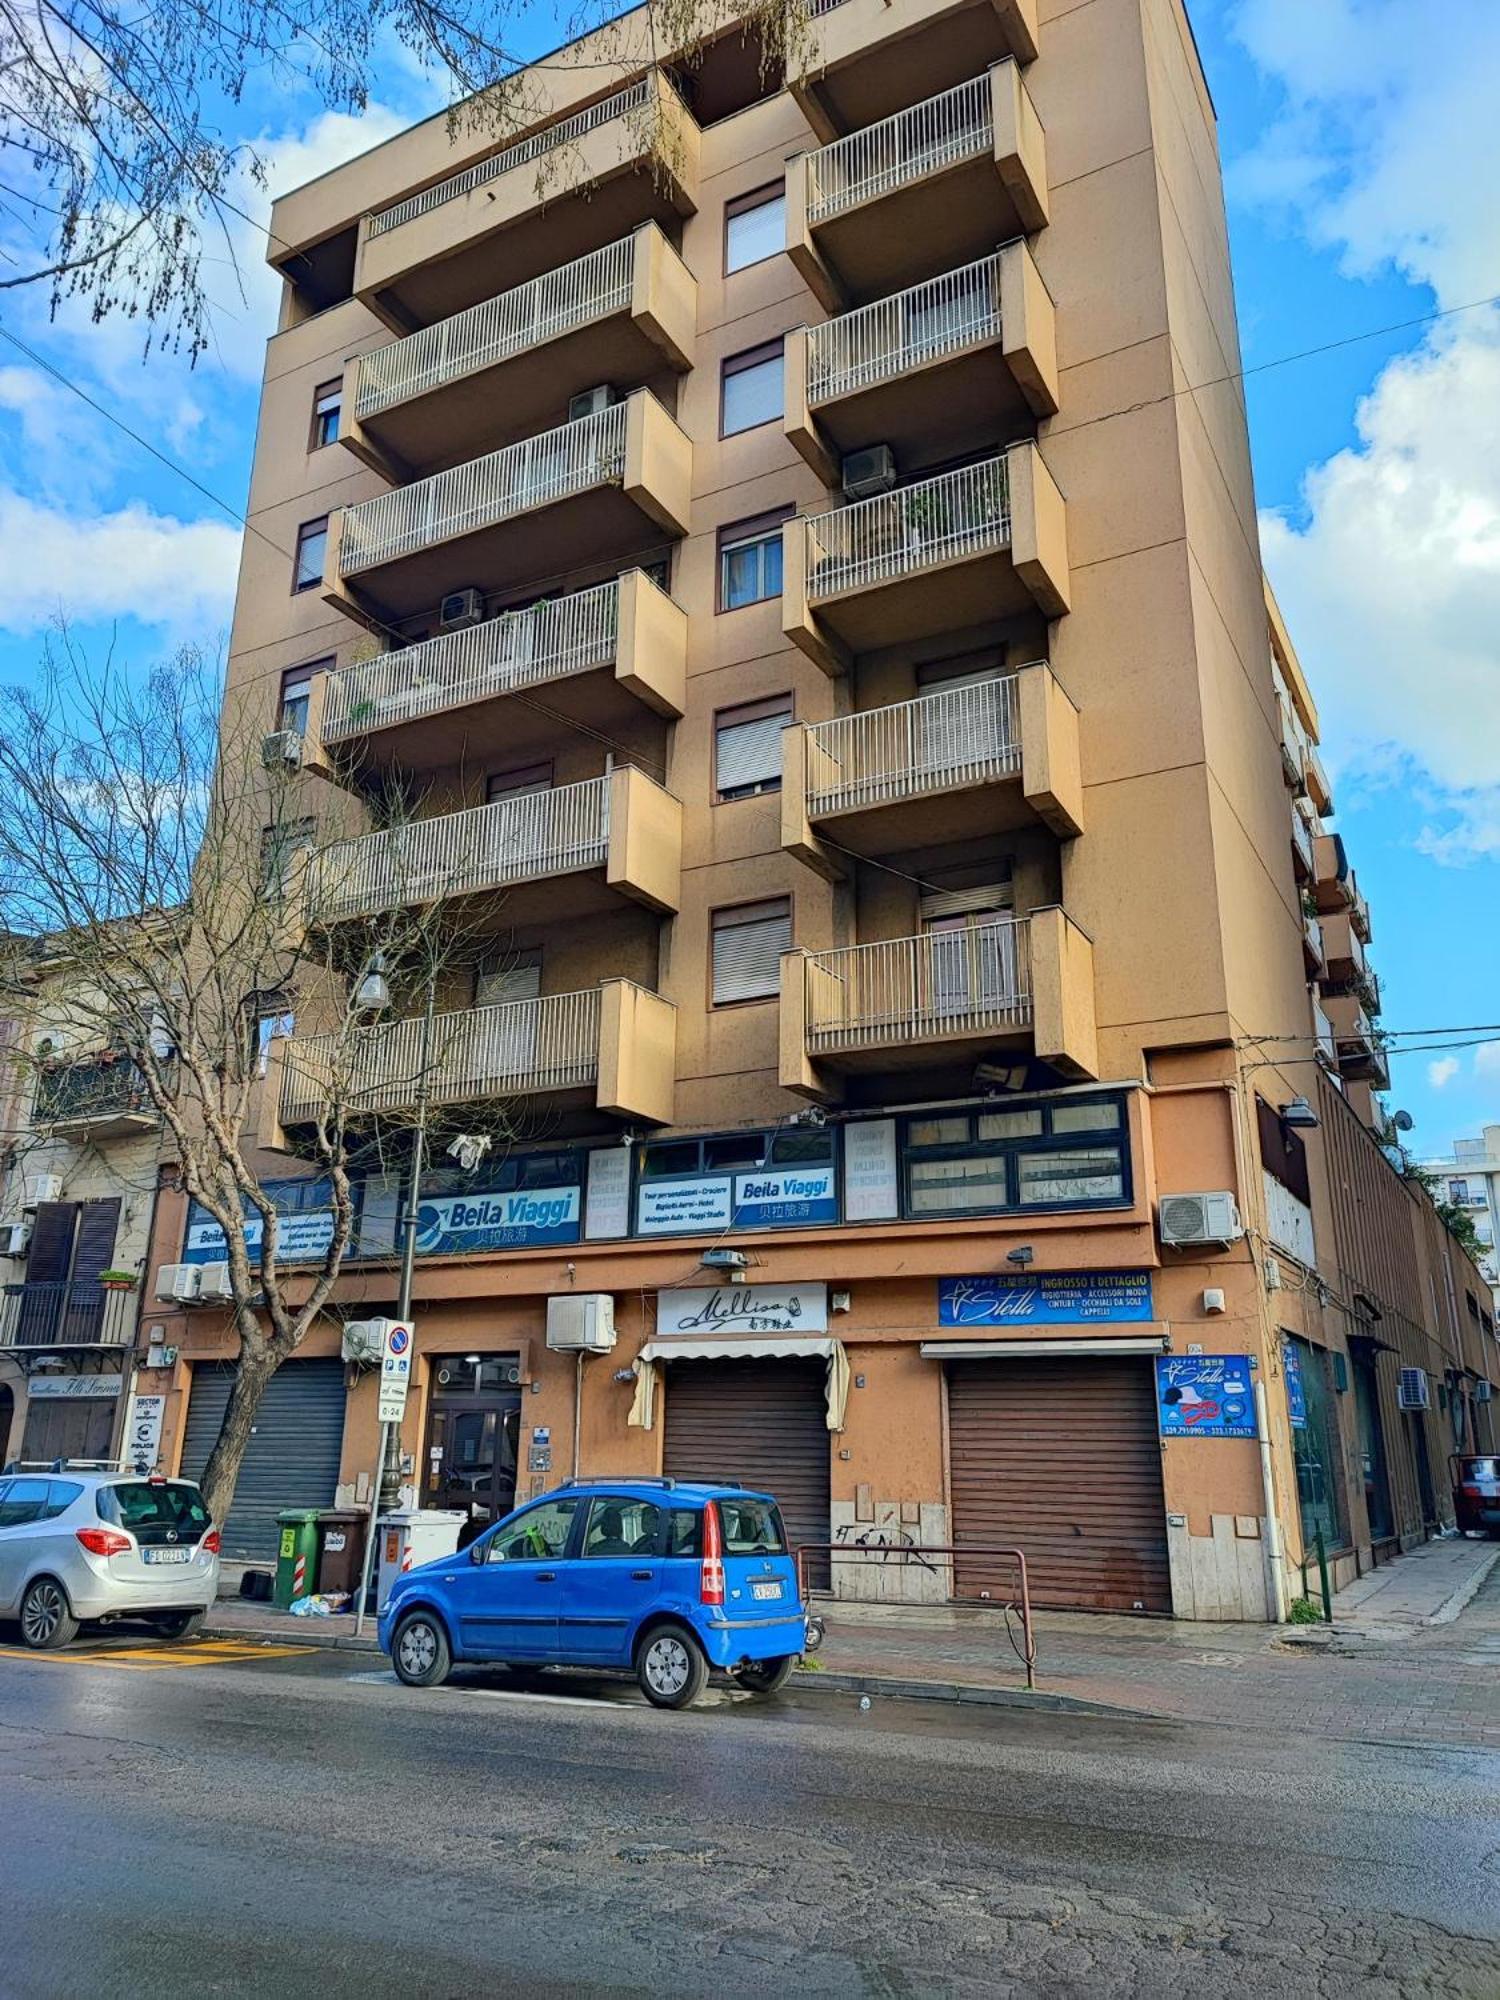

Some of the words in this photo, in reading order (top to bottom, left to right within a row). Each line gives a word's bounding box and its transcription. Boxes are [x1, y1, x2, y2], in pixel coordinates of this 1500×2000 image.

[743, 1181, 779, 1199] Beila
[783, 1176, 828, 1198] Viaggi
[450, 1201, 503, 1228] Beila
[508, 1192, 573, 1225] Viaggi
[1042, 1278, 1087, 1289] INGROSSO
[1090, 1278, 1096, 1287] E
[1098, 1275, 1147, 1287] DETTAGLIO
[1088, 1288, 1124, 1298] ACCESSORI
[1126, 1287, 1147, 1296] MODA
[960, 1288, 1037, 1322] Stella
[1114, 1298, 1124, 1306] DA
[1080, 1307, 1110, 1315] CAPPELLI
[1174, 1366, 1225, 1387] Stella
